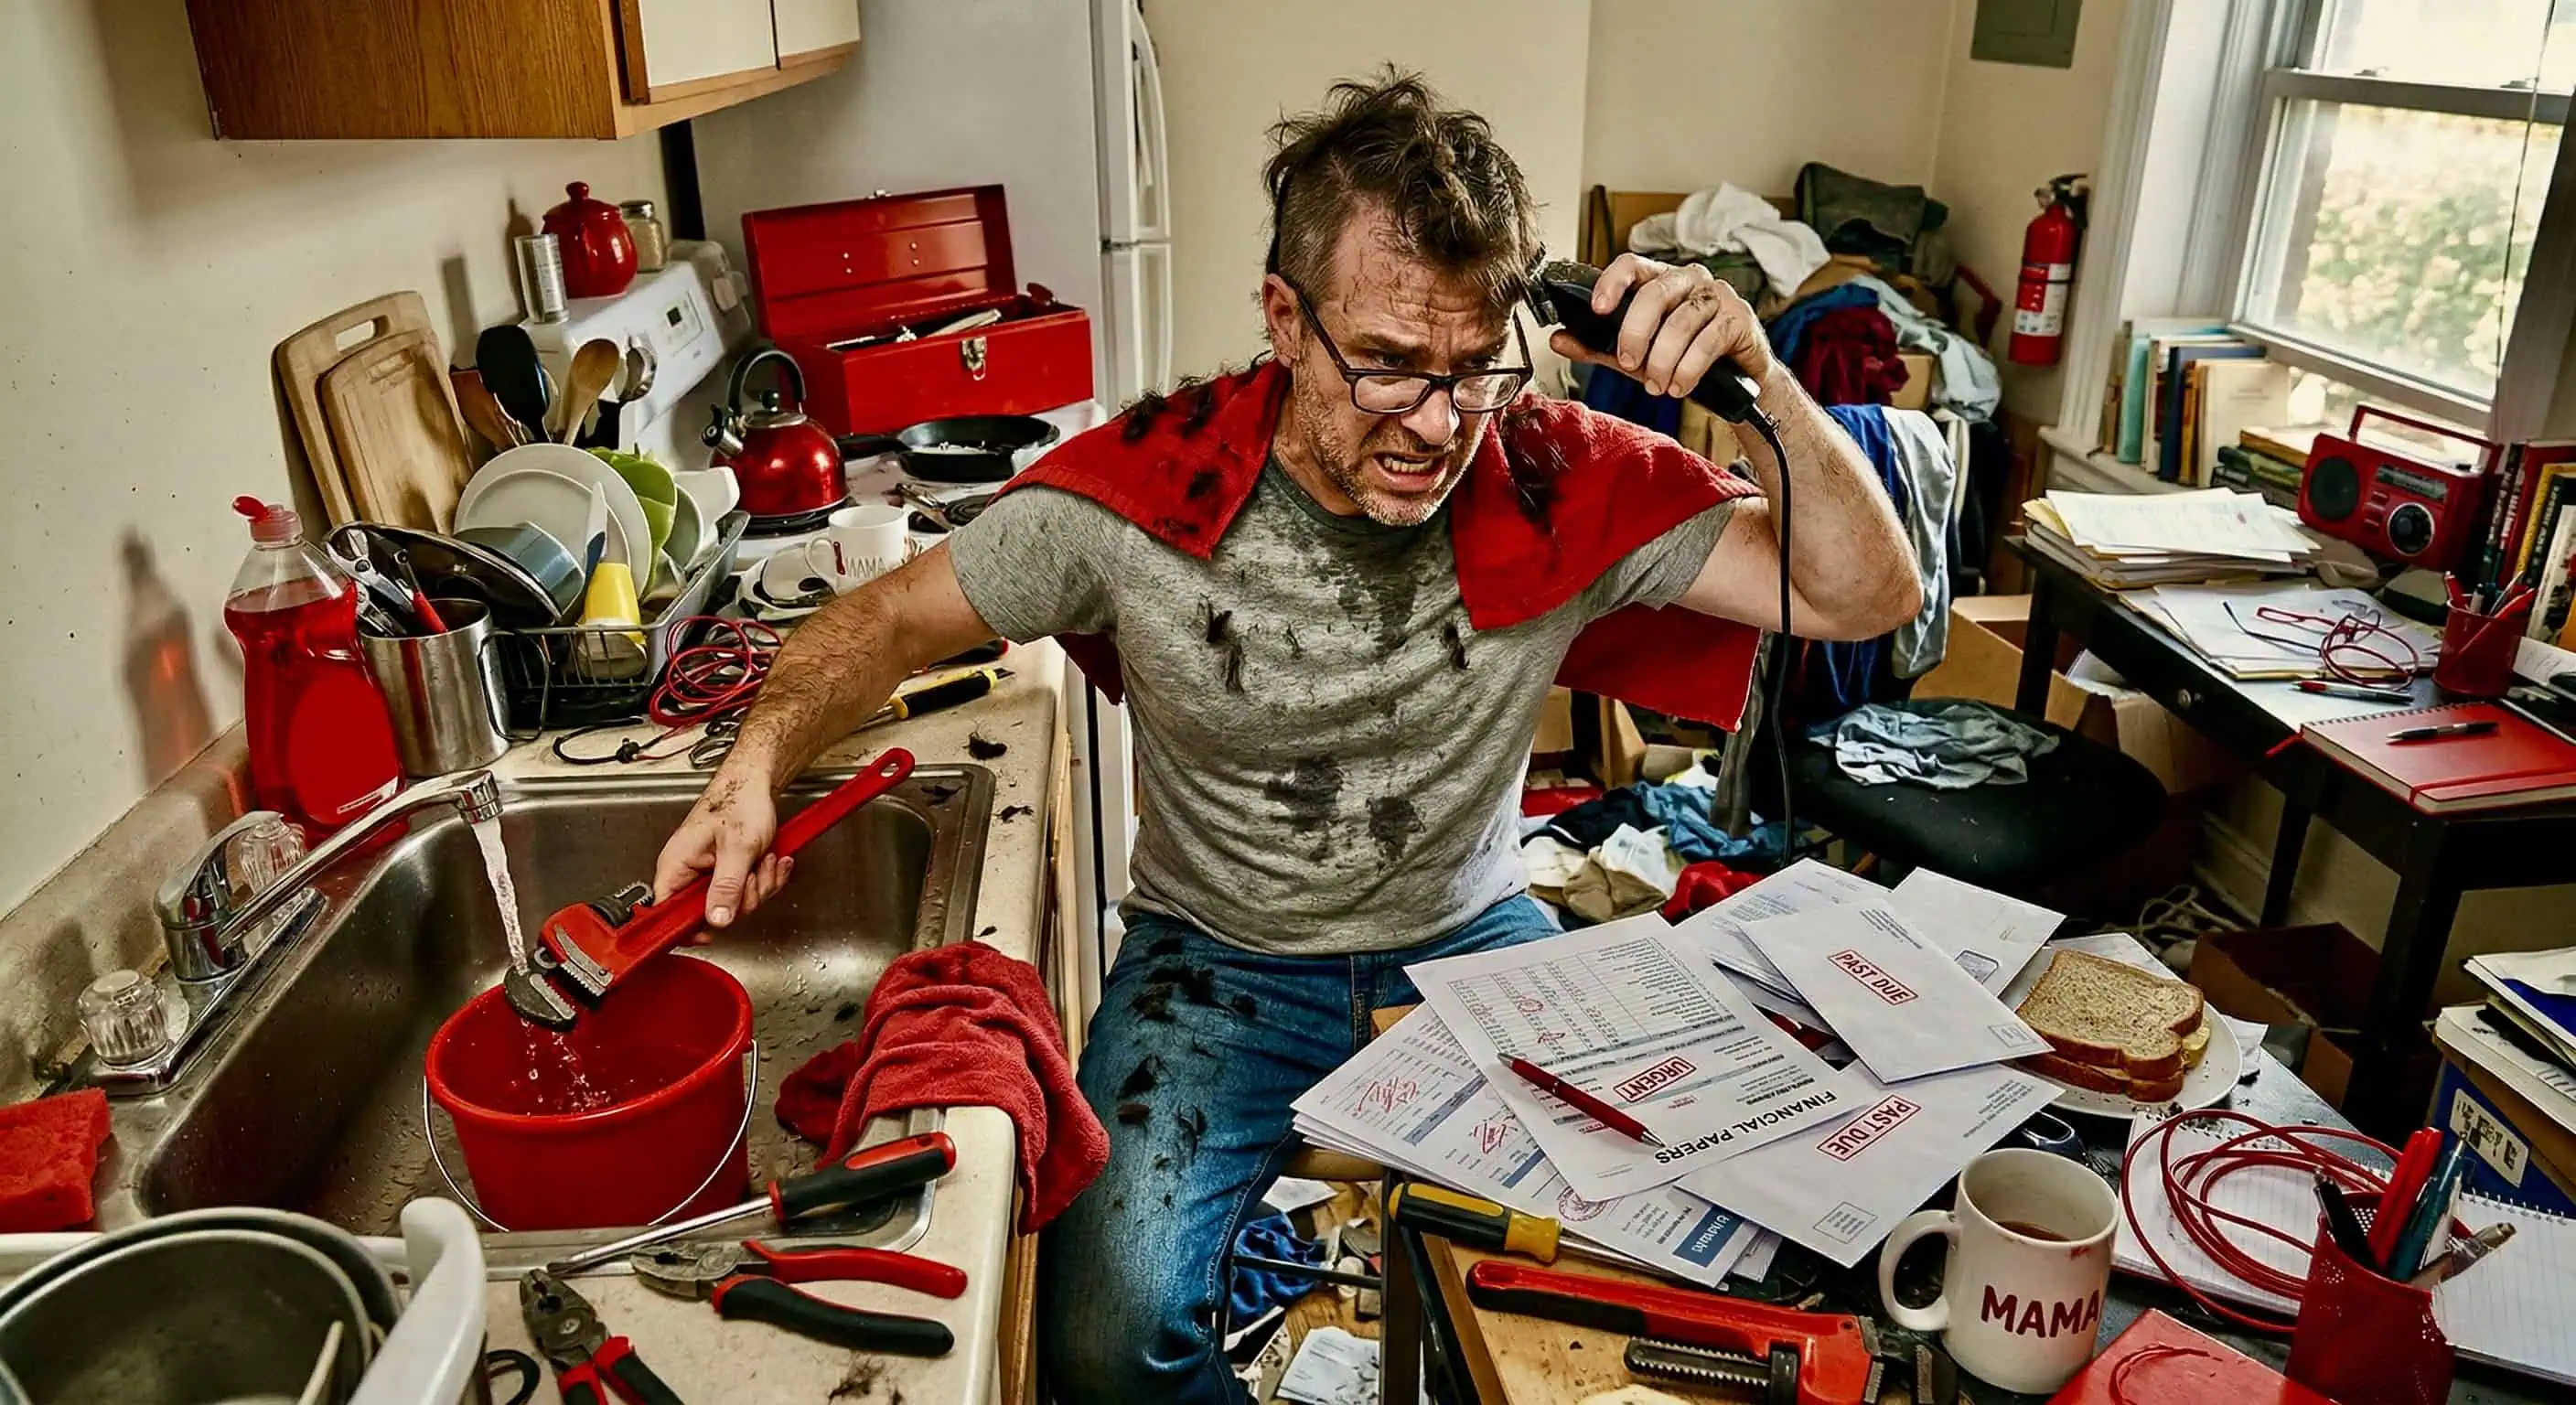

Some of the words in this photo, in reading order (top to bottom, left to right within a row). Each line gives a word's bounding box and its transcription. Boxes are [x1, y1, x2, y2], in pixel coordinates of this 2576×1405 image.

[1835, 954, 1878, 979] PAST
[1872, 979, 1910, 1002] DUE
[1621, 1061, 1690, 1099] URGENT
[1732, 1090, 1838, 1134] FINANCIAL
[1863, 1100, 1911, 1132] PAST
[1655, 1129, 1734, 1164] PAPERS
[1828, 1128, 1870, 1154] DUE
[1980, 1285, 2100, 1338] MAMA
